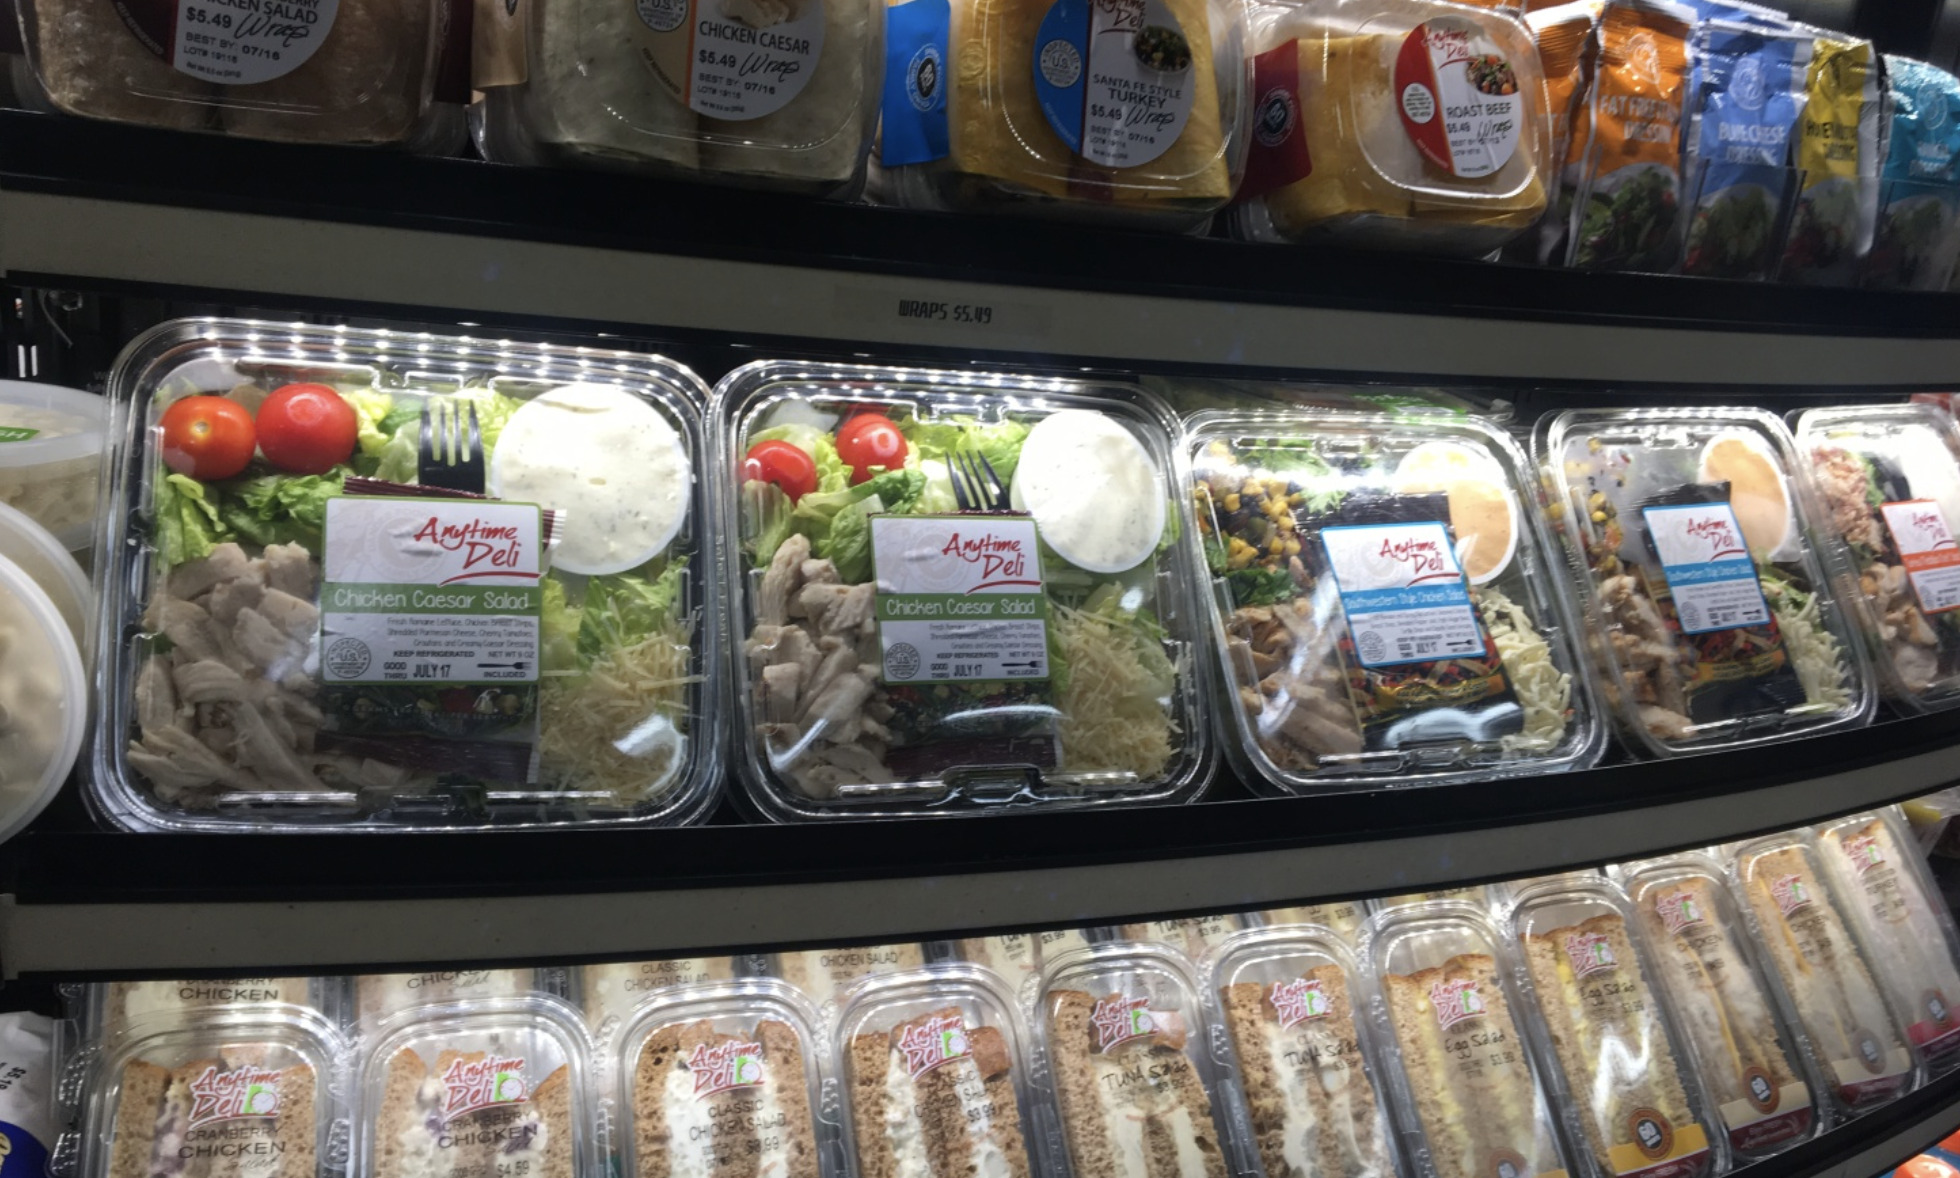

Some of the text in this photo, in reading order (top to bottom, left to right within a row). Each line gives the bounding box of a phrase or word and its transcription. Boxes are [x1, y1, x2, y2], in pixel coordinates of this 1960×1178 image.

[264, 1, 318, 24] SALAD
[186, 7, 309, 48] $5.49 Wrap
[186, 32, 216, 45] BEST
[699, 21, 811, 55] CHICKEN CAESAR
[698, 50, 800, 83] $5.49 Wrap
[698, 73, 723, 85] BEST
[1092, 74, 1131, 91] SANTA
[1133, 81, 1146, 94] FE
[1149, 85, 1183, 100] STYLE
[1108, 87, 1167, 109] TURKEY
[1446, 102, 1483, 118] ROAST
[1485, 102, 1512, 115] BEEF
[1090, 103, 1176, 132] $5.49 Wrap
[898, 299, 993, 324] WRAPS $5.49
[413, 516, 518, 551] Anytime
[462, 540, 523, 570] Deli
[942, 533, 1022, 563] Anytime
[1379, 537, 1438, 562] Anytime
[982, 553, 1026, 579] Deli
[1411, 551, 1444, 575] Deli
[333, 588, 529, 610] Chicken Caesar Salad
[886, 598, 1036, 616] Chicken Caesar Salad
[383, 661, 407, 670] GOOD
[393, 650, 475, 658] KEEP REFRIGERATED
[487, 651, 503, 659] NET
[384, 672, 408, 680] THRU
[413, 664, 452, 679] JULY 17
[953, 664, 983, 677] JULY 17
[641, 960, 692, 974] CLASSIC
[820, 950, 899, 968] CHICKEN SALAD
[179, 987, 280, 1000] CHICKEN
[624, 976, 673, 992] CHICKEN
[1091, 998, 1149, 1022] Anytime
[901, 1016, 963, 1047] Anytime
[1098, 1018, 1132, 1046] Deli
[689, 1041, 762, 1069] Anytime
[1445, 1029, 1506, 1060] Egg Salad
[906, 1040, 943, 1074] Deli
[190, 1066, 281, 1095] Anytime
[444, 1056, 527, 1086] Anytime
[693, 1069, 735, 1093] Deli
[1102, 1064, 1146, 1091] TUNA
[189, 1091, 243, 1120] Deli
[446, 1080, 494, 1111] Deli
[708, 1099, 764, 1118] CLASSIC
[184, 1121, 288, 1142] CRANBERRY
[438, 1123, 538, 1149] CHICKEN
[690, 1112, 786, 1141] CHICKEN SALAD
[178, 1141, 287, 1159] CHICKEN
